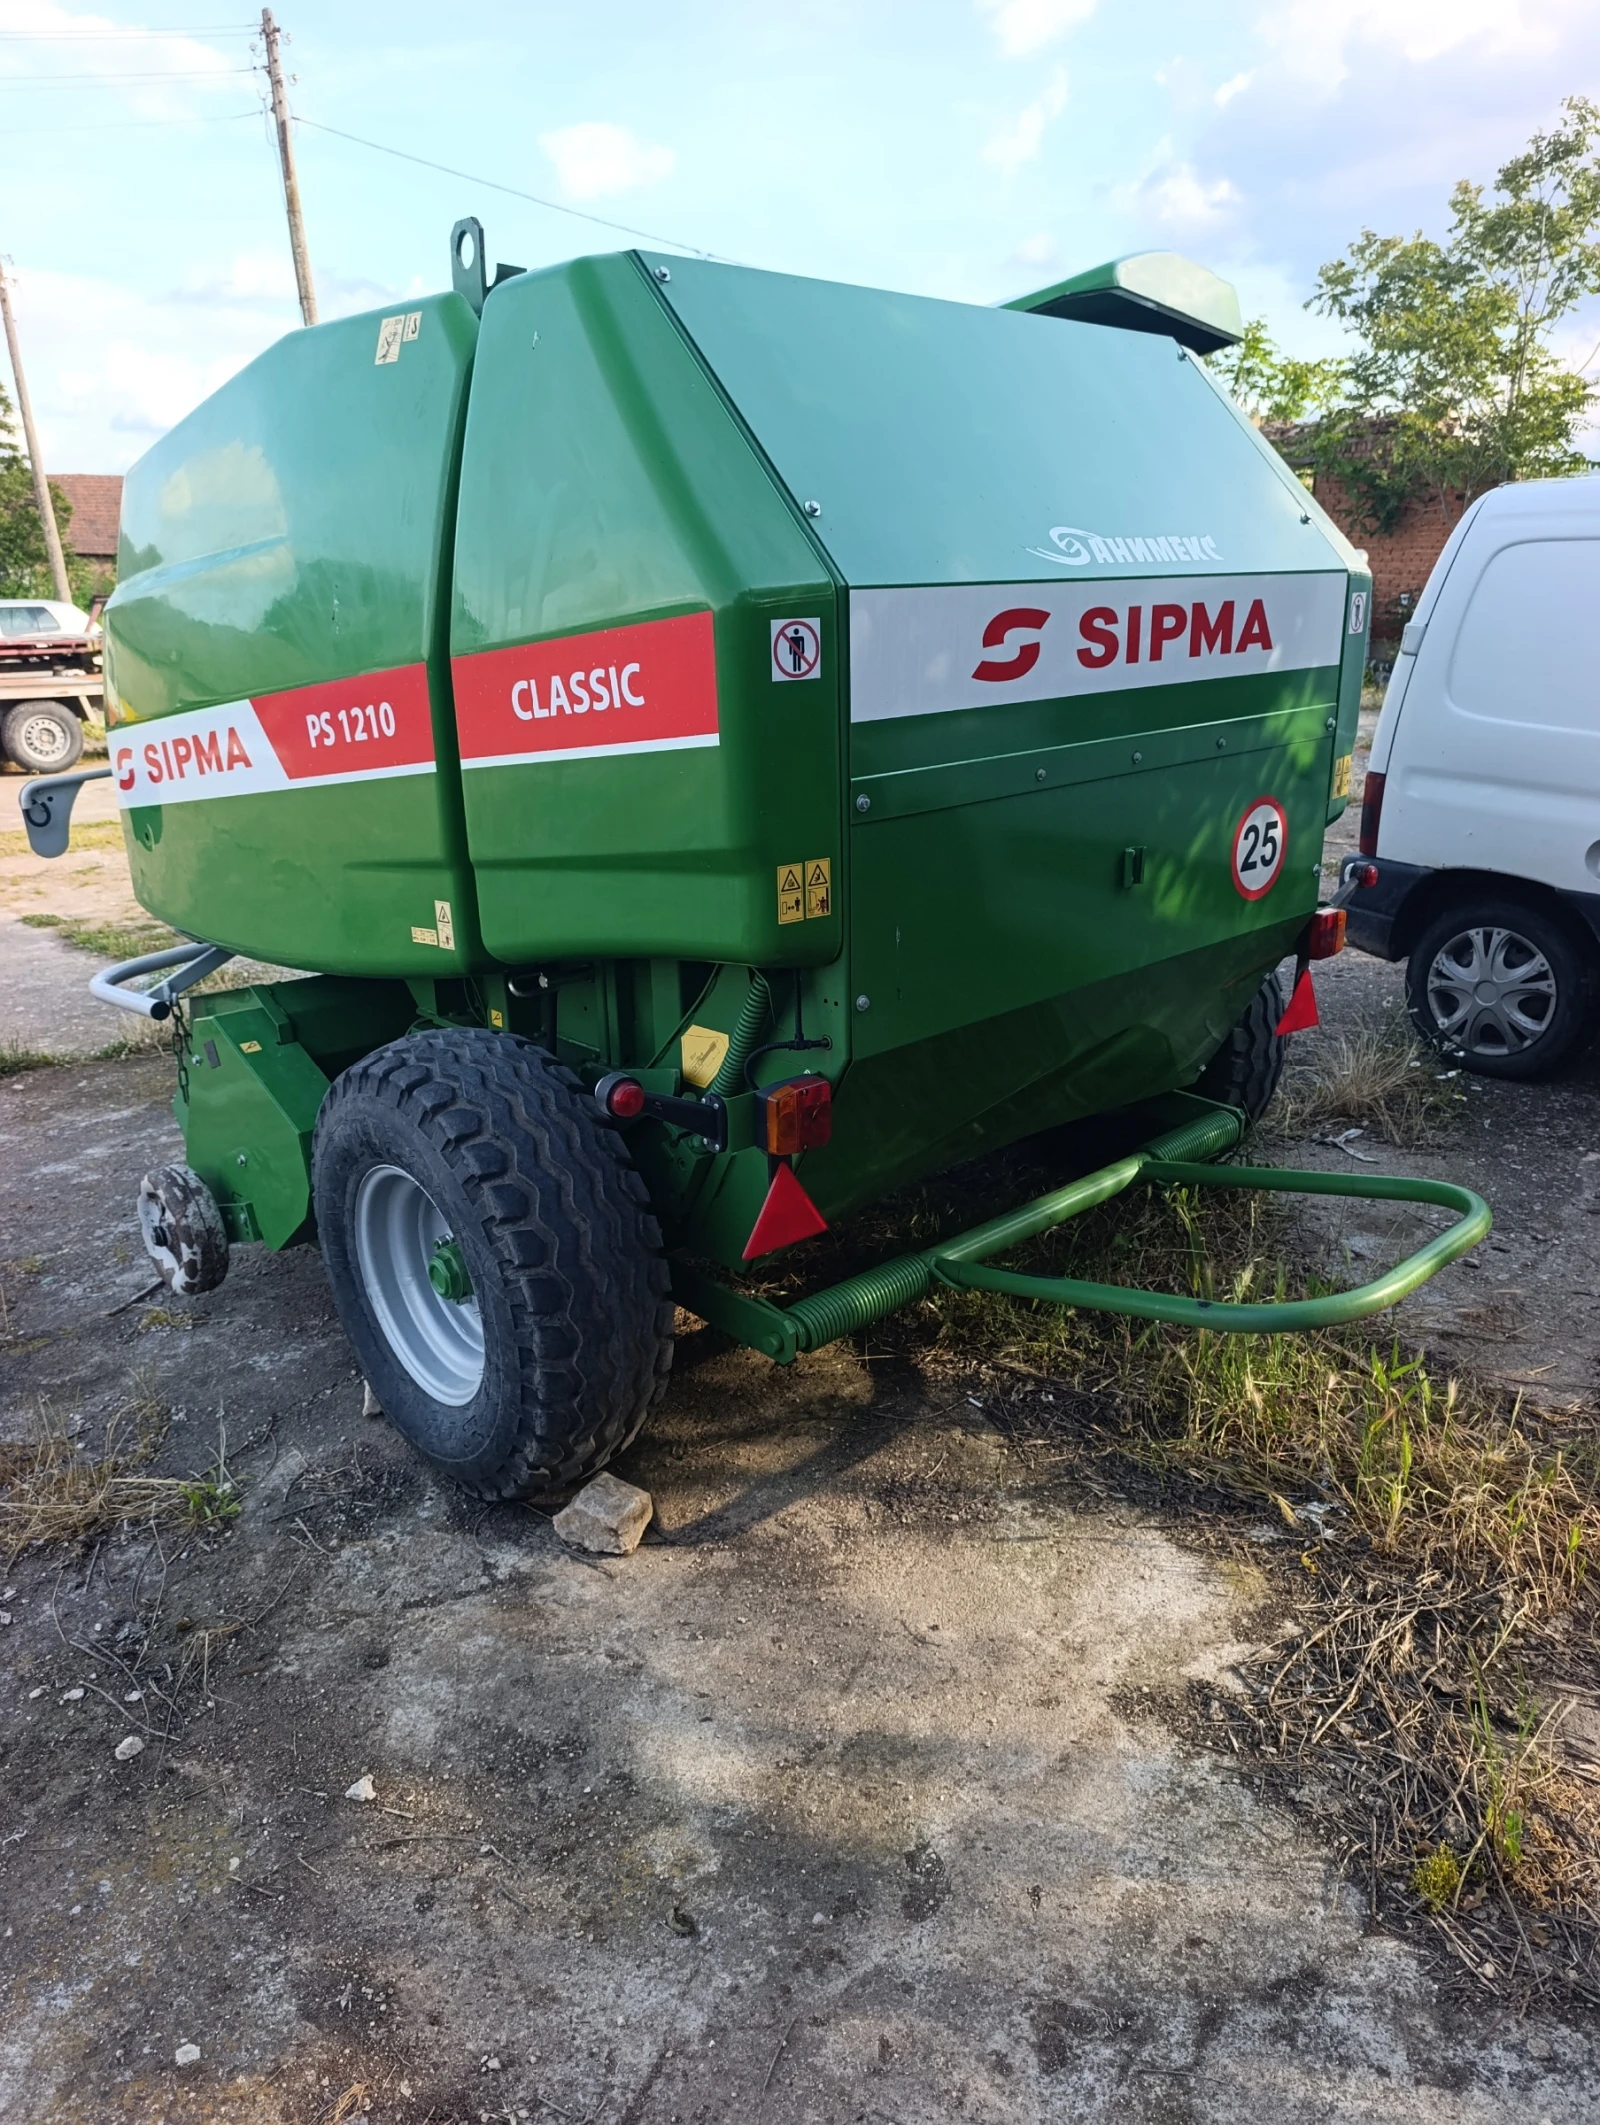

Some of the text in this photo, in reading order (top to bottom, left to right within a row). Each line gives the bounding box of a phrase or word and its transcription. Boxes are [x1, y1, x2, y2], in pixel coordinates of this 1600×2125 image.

[1076, 599, 1273, 669] SIPMA
[511, 662, 645, 721] CLASSIC
[305, 702, 396, 749] PS 1210
[143, 726, 253, 784] SIPMA
[1239, 820, 1279, 873] 25
